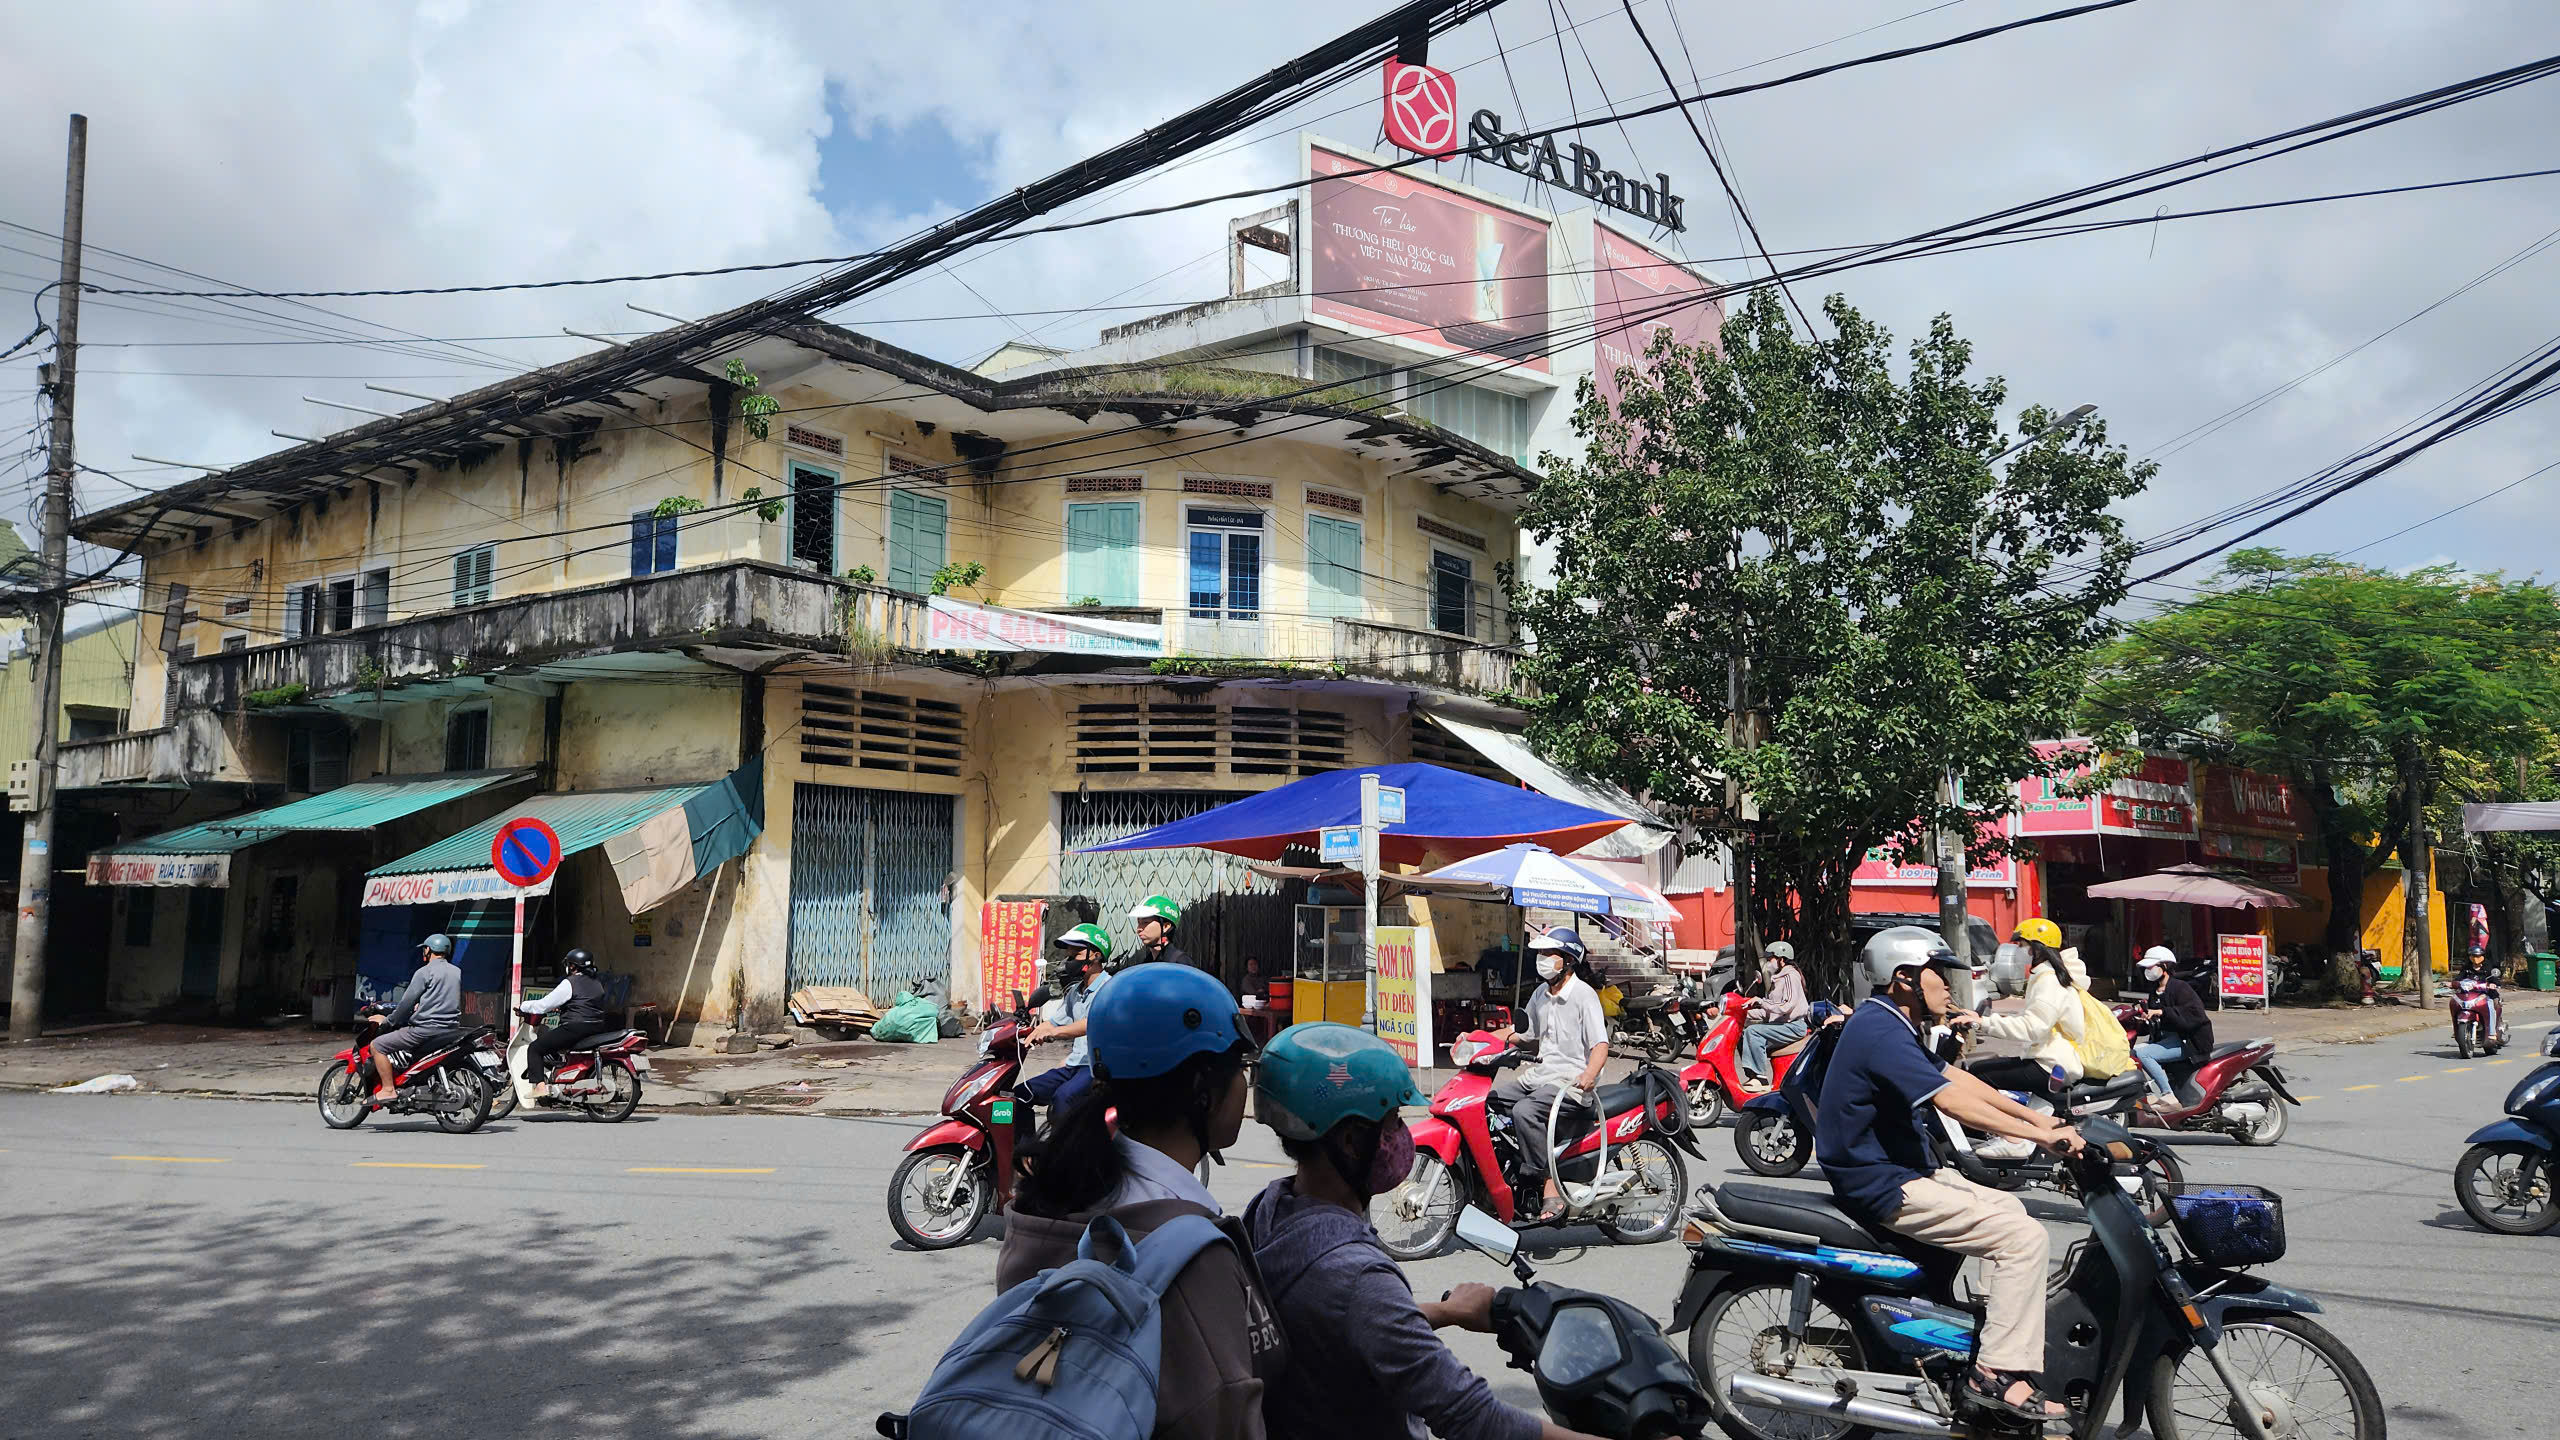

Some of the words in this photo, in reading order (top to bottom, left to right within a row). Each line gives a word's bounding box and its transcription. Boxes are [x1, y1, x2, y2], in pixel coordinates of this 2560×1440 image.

[1469, 109, 1687, 233] SeABank
[1333, 222, 1379, 245] THƯƠNG
[1382, 236, 1405, 252] HIỆU
[1439, 254, 1456, 268] GIA
[1360, 244, 1383, 260] VIỆT
[1385, 252, 1409, 268] NAM
[1411, 259, 1432, 274] 2024
[1069, 634, 1086, 649] 170
[2057, 801, 2088, 811] Kim
[1900, 869, 1921, 878] 109
[1974, 871, 2003, 879] Trinh
[367, 876, 434, 902] PHƯƠNG
[993, 1108, 1012, 1117] Grab
